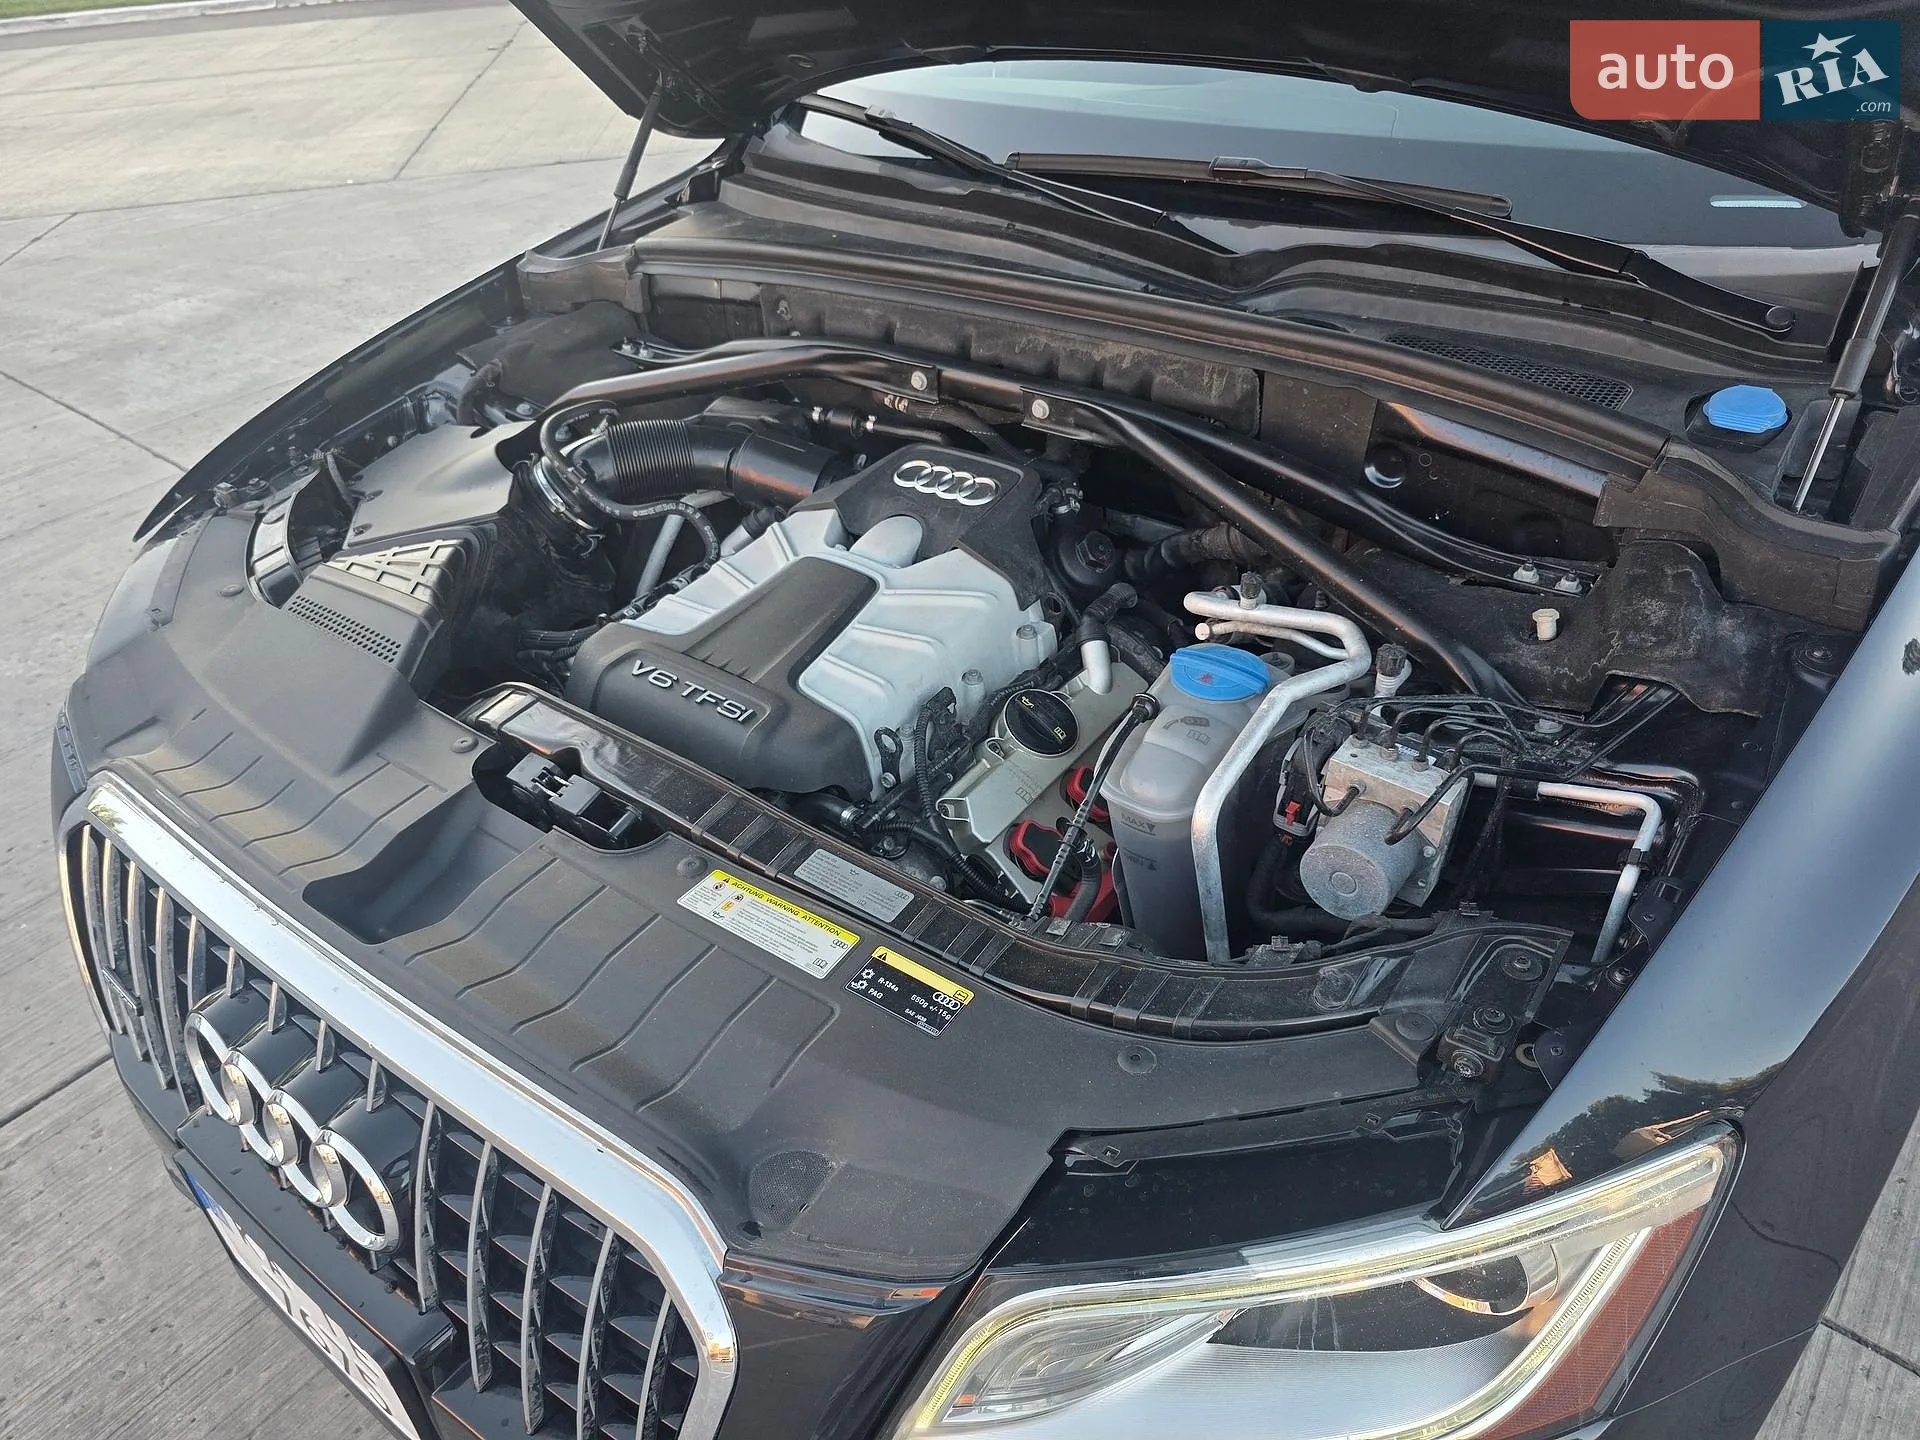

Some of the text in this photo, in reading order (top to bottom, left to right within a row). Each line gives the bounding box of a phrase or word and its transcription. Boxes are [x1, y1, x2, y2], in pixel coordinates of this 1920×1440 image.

[631, 659, 756, 723] V6 TFSI
[731, 881, 765, 900] ACHTUNG
[766, 898, 800, 917] WARNING
[801, 914, 842, 937] ATTENTION
[262, 1266, 393, 1416] 7675
